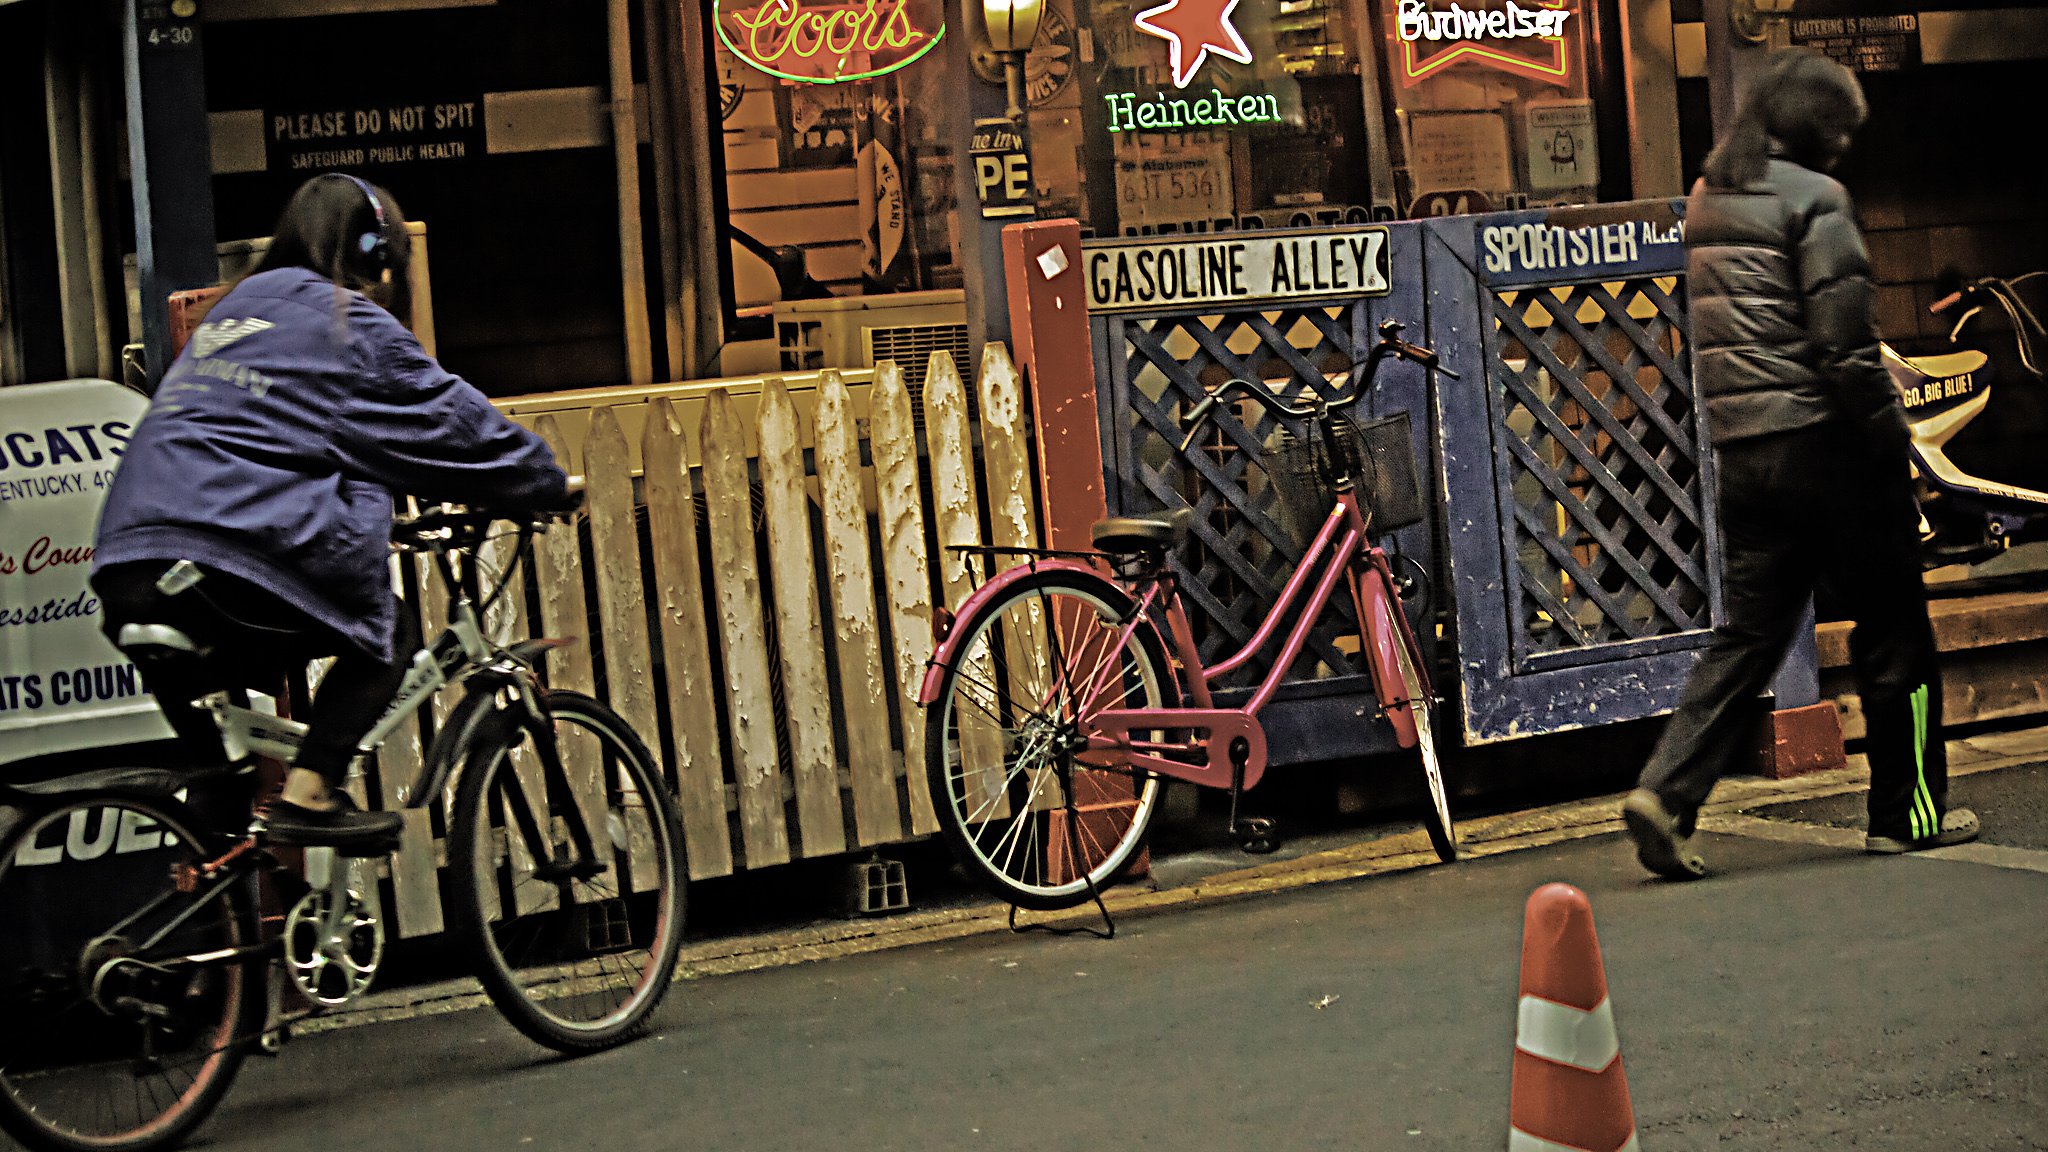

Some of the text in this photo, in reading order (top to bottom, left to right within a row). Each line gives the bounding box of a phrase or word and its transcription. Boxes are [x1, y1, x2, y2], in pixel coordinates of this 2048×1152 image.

[732, 0, 924, 62] Coors
[274, 102, 475, 141] PLEASE DO NOT SPIT
[1104, 88, 1282, 133] Heineken
[291, 140, 466, 169] SAFEGUARD PUBLIC HEALTH
[974, 153, 1029, 202] PE
[1091, 236, 1370, 304] GASOLINE ALLEY
[1483, 220, 1639, 273] SPORTSTER
[1924, 381, 1942, 403] BIG
[1944, 373, 1973, 398] BLUE!
[0, 421, 131, 471] CATS
[51, 663, 153, 706] COUN
